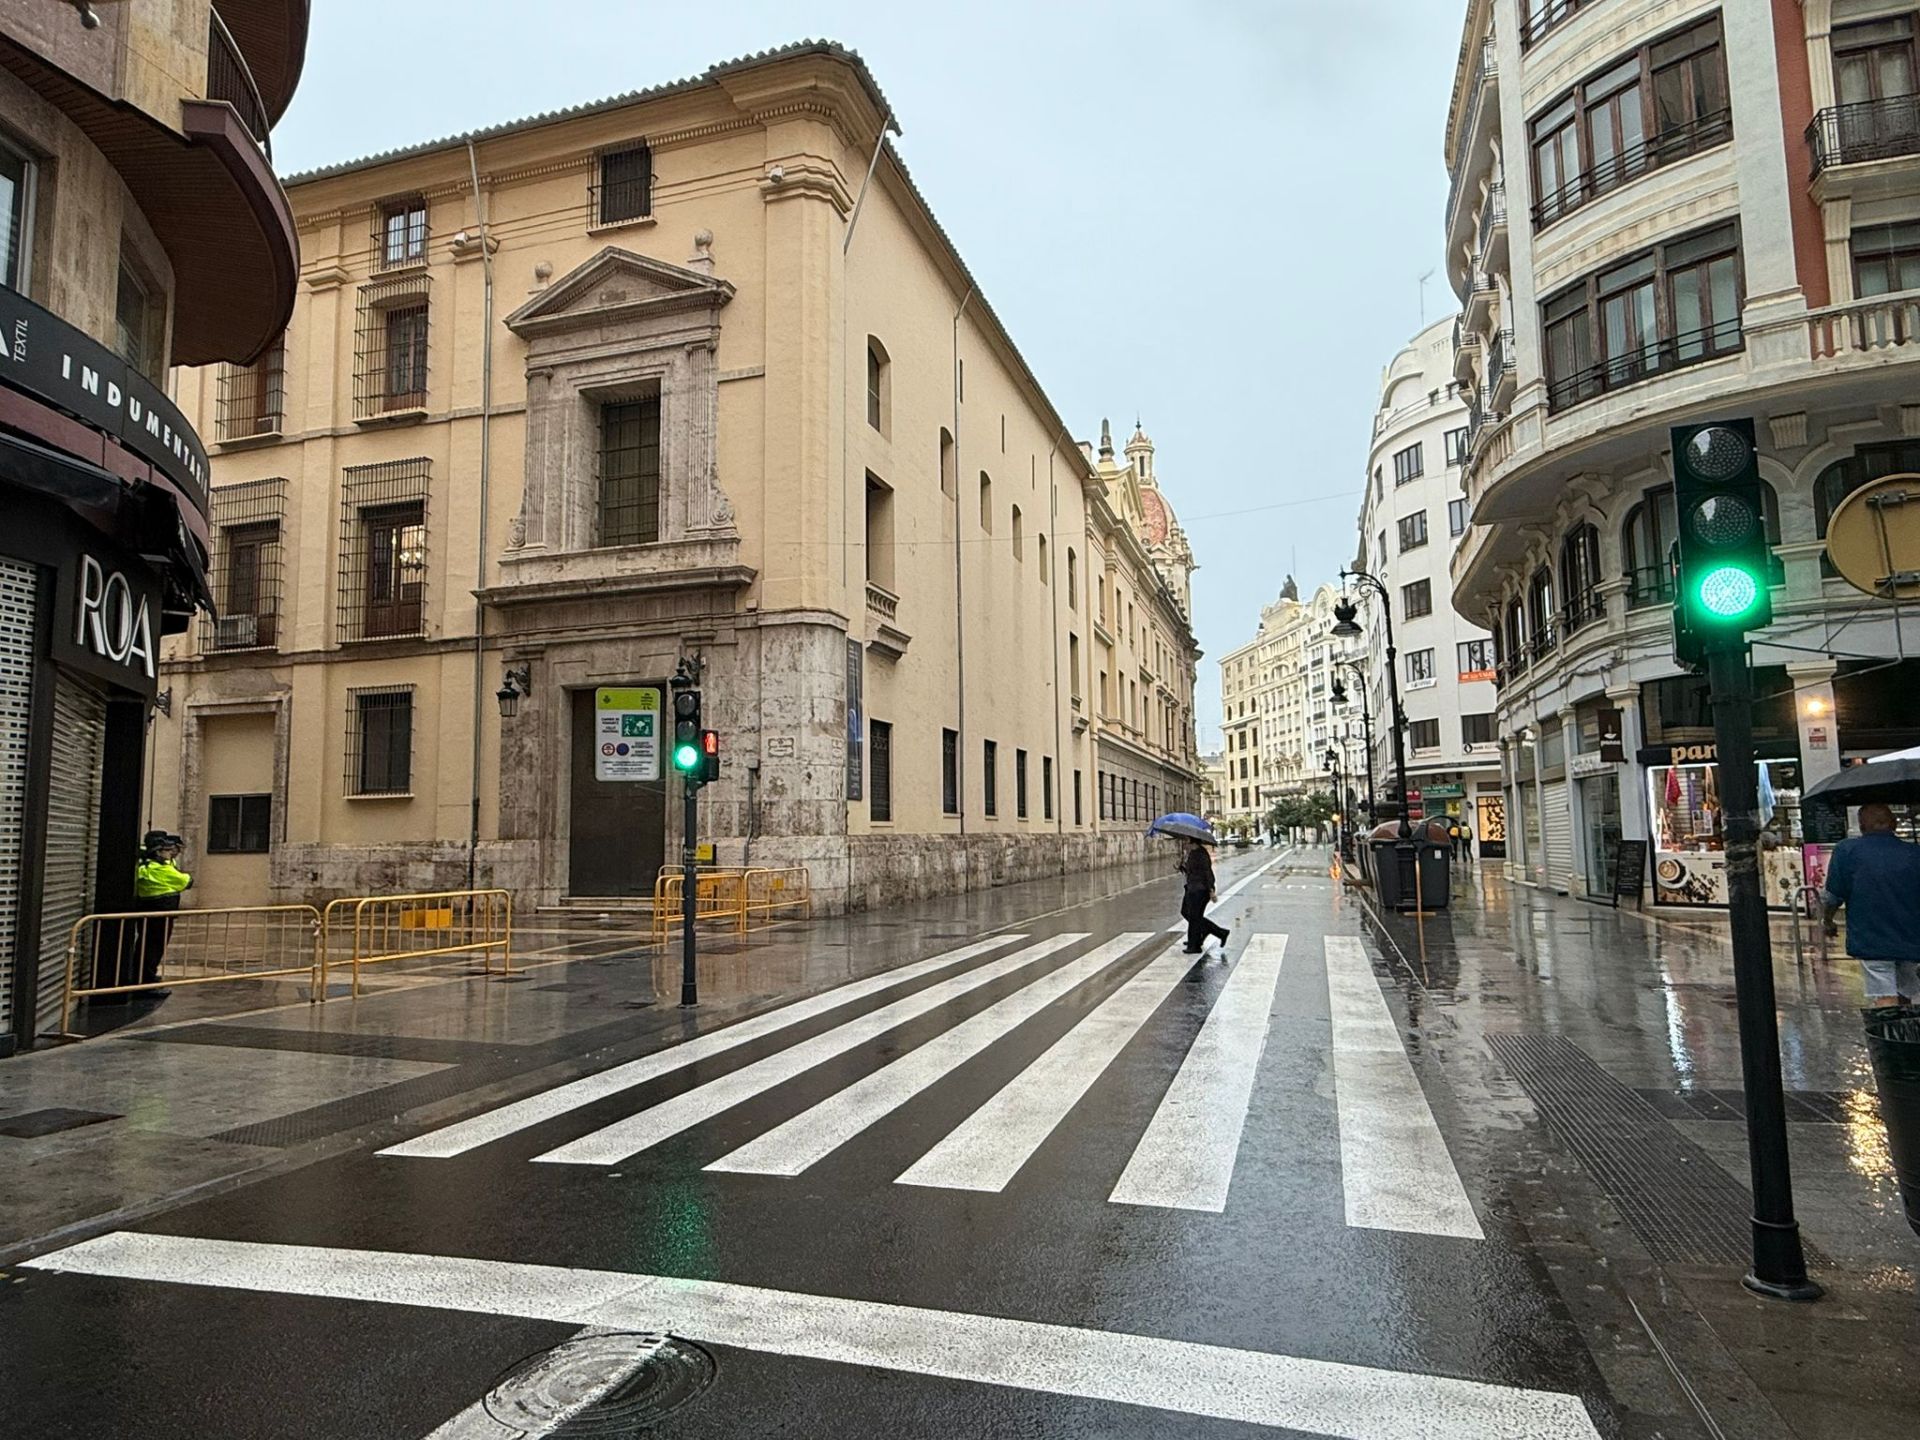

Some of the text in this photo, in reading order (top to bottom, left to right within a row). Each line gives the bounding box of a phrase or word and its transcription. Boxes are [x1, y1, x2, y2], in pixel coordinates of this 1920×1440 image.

[13, 319, 28, 362] TEXTIL
[77, 554, 155, 679] ROA
[1671, 744, 1718, 767] pan
